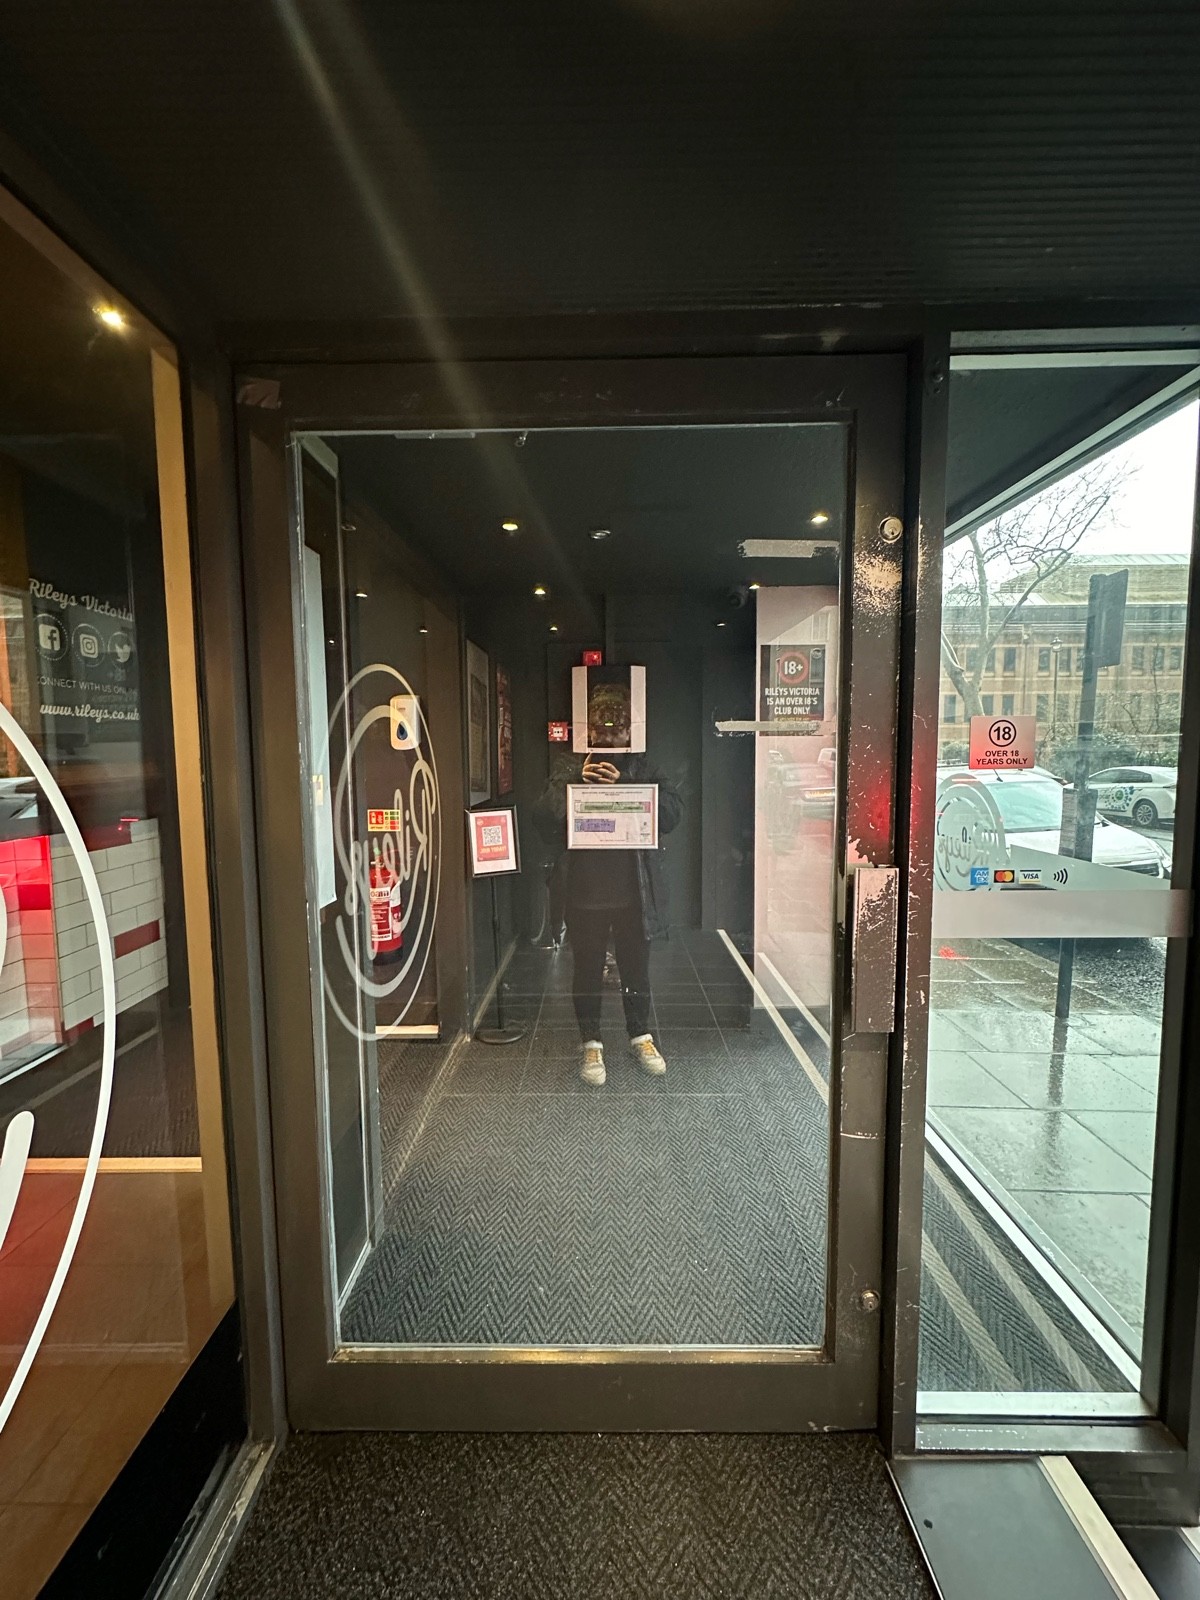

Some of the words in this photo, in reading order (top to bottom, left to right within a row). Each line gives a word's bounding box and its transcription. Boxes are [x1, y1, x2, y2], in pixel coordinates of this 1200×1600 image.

[29, 578, 78, 608] Rileys
[81, 595, 134, 621] Victoria
[784, 661, 803, 675] 18+
[79, 681, 100, 691] WITH
[102, 684, 111, 693] US
[765, 687, 788, 696] RILEYS
[789, 687, 820, 696] VICTORIA
[767, 697, 774, 705] IS
[775, 697, 785, 705] AN
[786, 697, 803, 705] OVER
[804, 697, 818, 705] 18'S
[40, 703, 139, 722] www.rileys.co.uk
[774, 706, 792, 715] CLUB
[793, 706, 810, 715] ONLY
[993, 726, 1012, 741] 18
